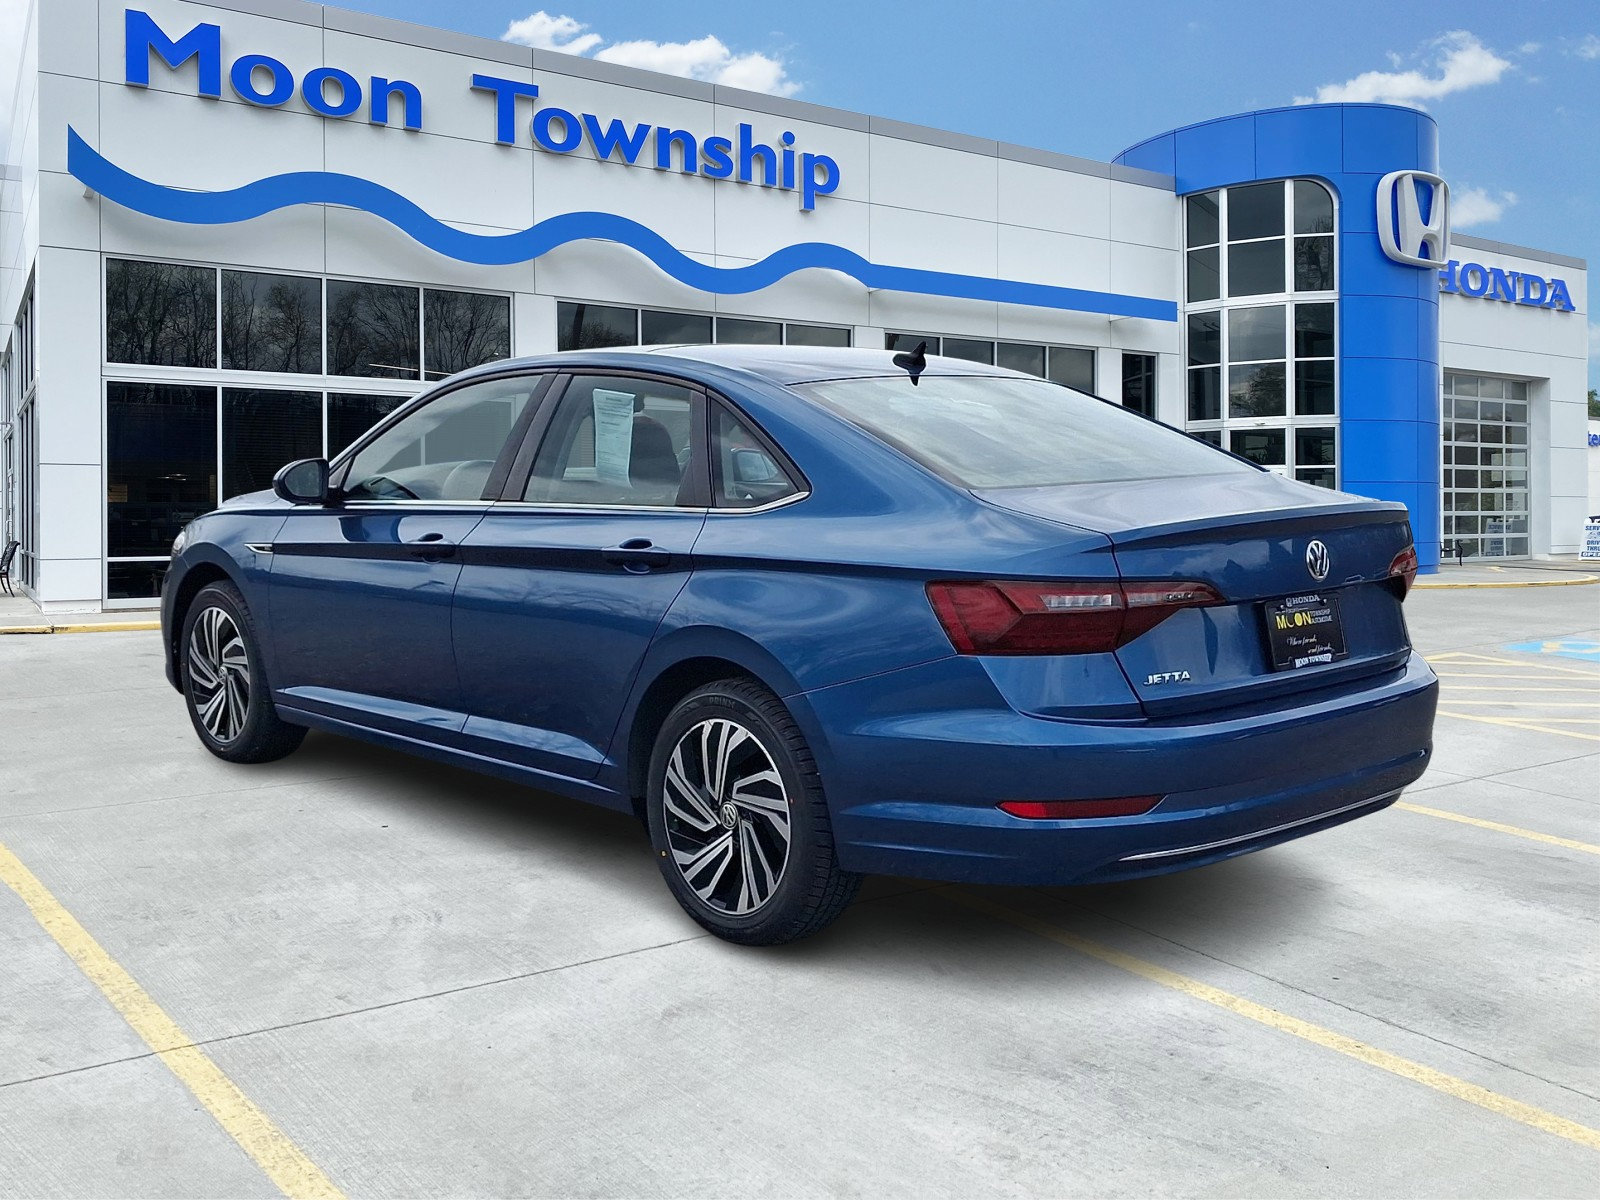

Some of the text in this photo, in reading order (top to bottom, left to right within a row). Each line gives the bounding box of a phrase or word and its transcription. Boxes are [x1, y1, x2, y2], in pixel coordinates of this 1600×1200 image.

[125, 8, 840, 212] Moon Township
[1292, 594, 1321, 604] HONDA
[1276, 611, 1312, 630] MOON
[1295, 656, 1309, 668] MOON
[1143, 670, 1191, 685] JETTA
